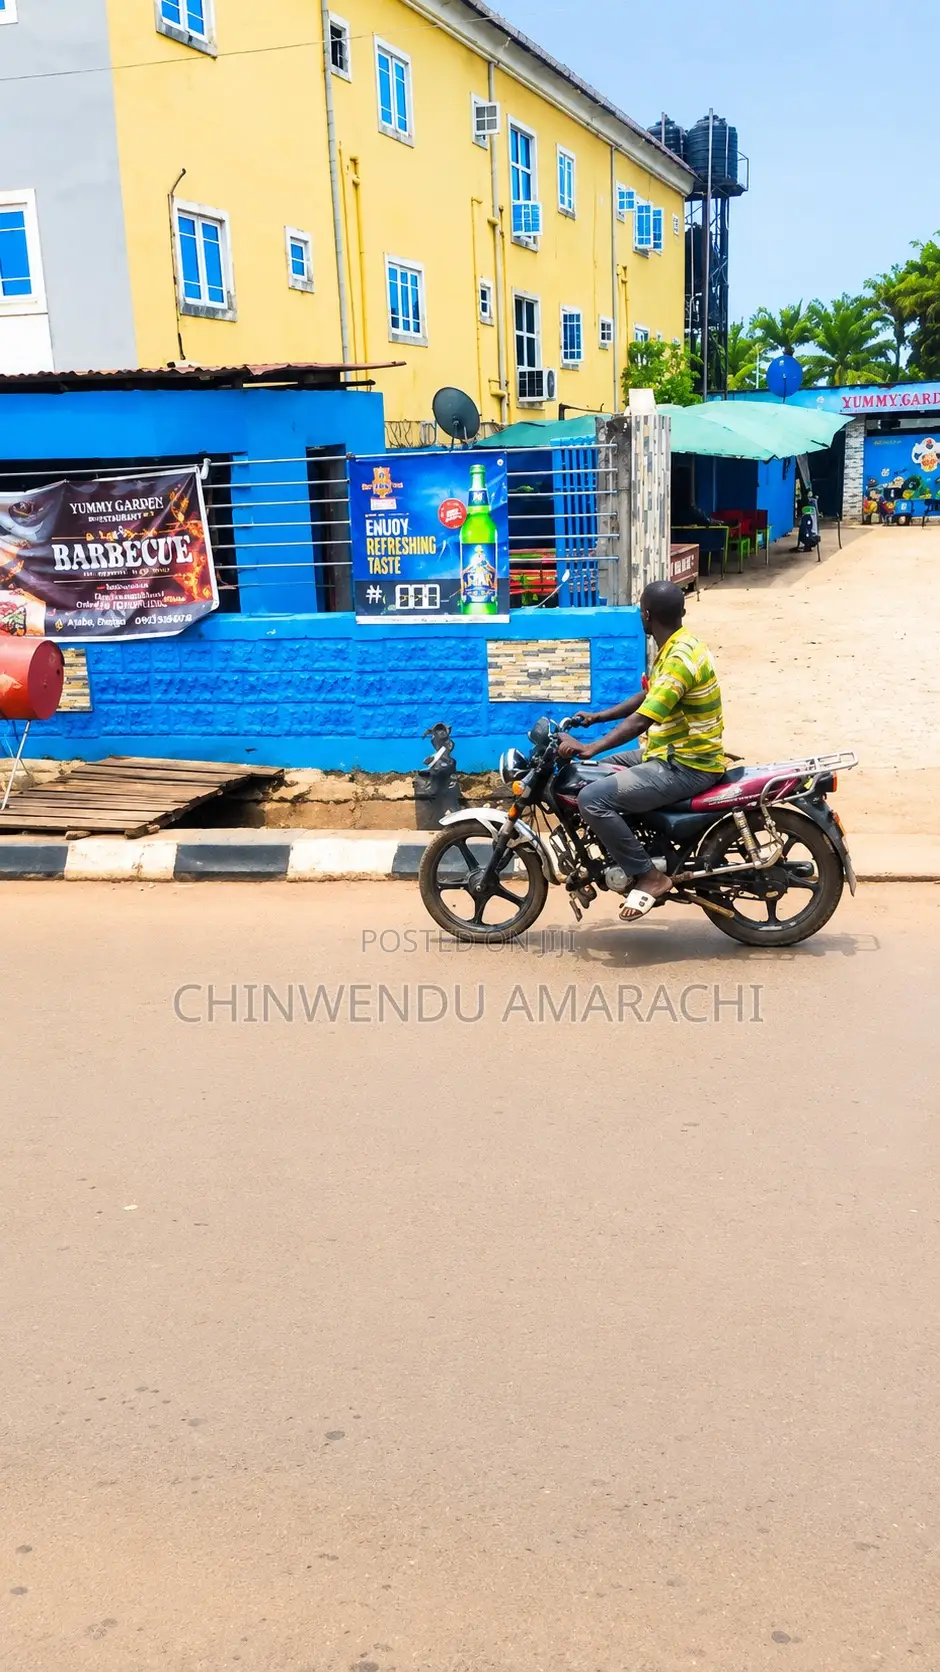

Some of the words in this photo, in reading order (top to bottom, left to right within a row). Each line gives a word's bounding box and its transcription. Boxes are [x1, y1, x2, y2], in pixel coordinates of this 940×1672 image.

[842, 394, 898, 409] YUMMY
[70, 501, 112, 514] YUMMY
[115, 497, 164, 512] GARDEN
[366, 518, 409, 536] ENJOY
[51, 535, 193, 571] BARBECUE
[366, 536, 436, 556] REFRESHING
[368, 557, 401, 575] TASTE
